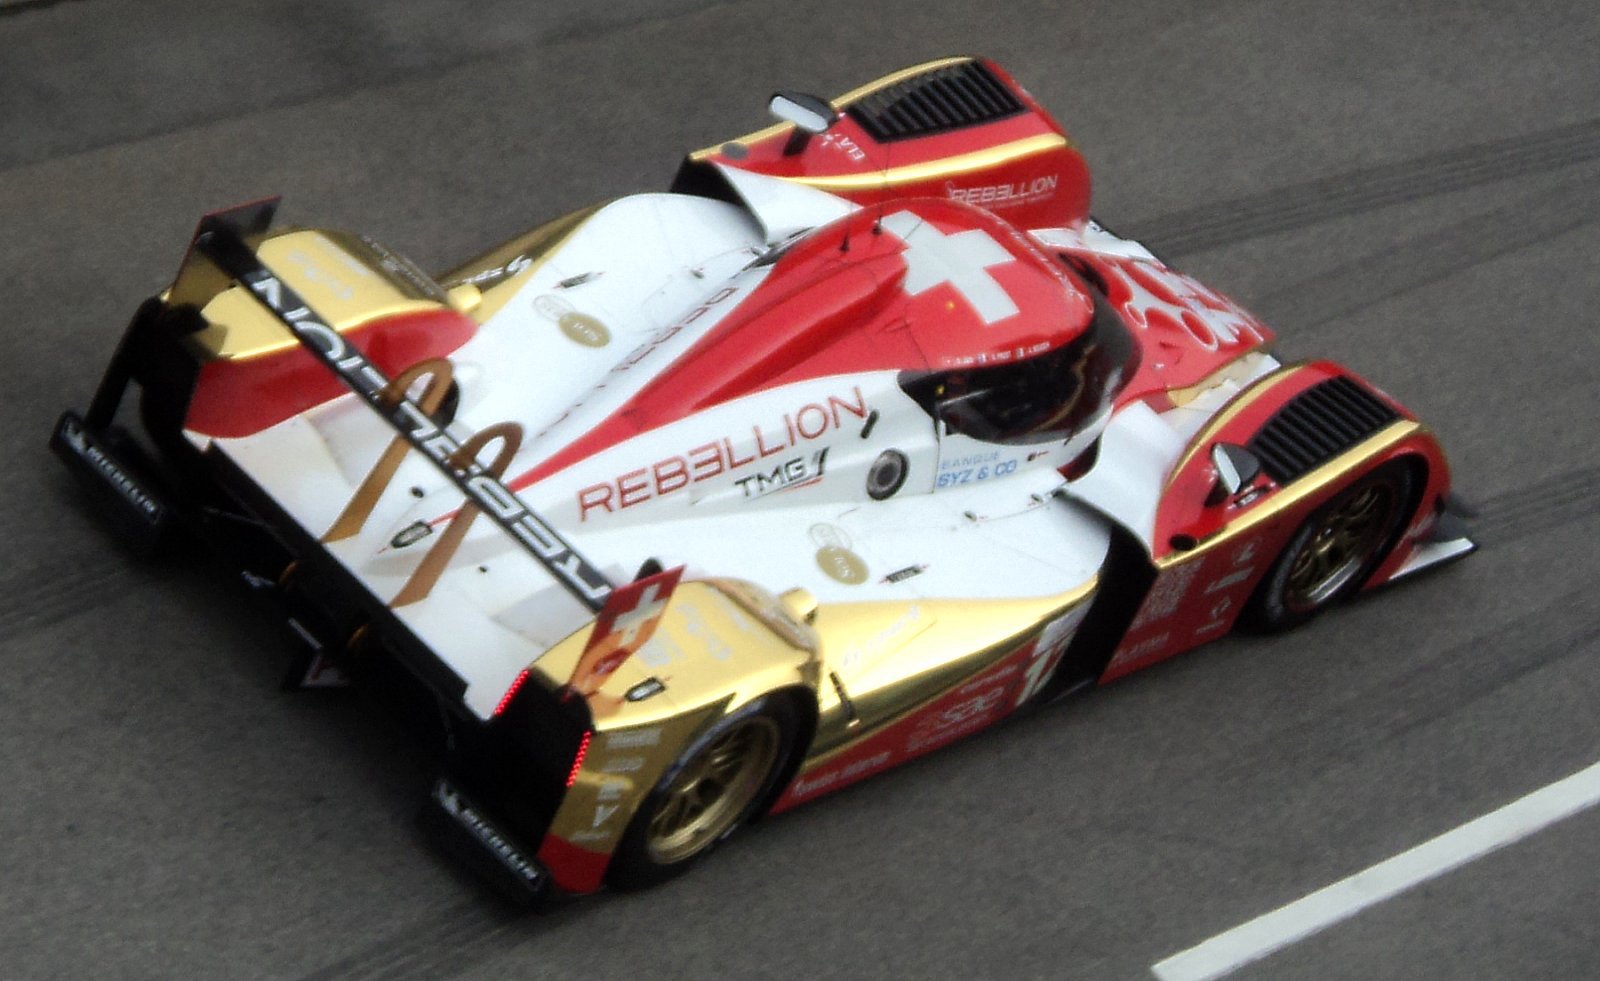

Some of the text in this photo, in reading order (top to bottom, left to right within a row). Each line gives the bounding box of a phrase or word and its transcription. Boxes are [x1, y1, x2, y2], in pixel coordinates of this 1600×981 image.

[577, 386, 868, 522] REBELLION
[937, 459, 1018, 488] SYZ & CO
